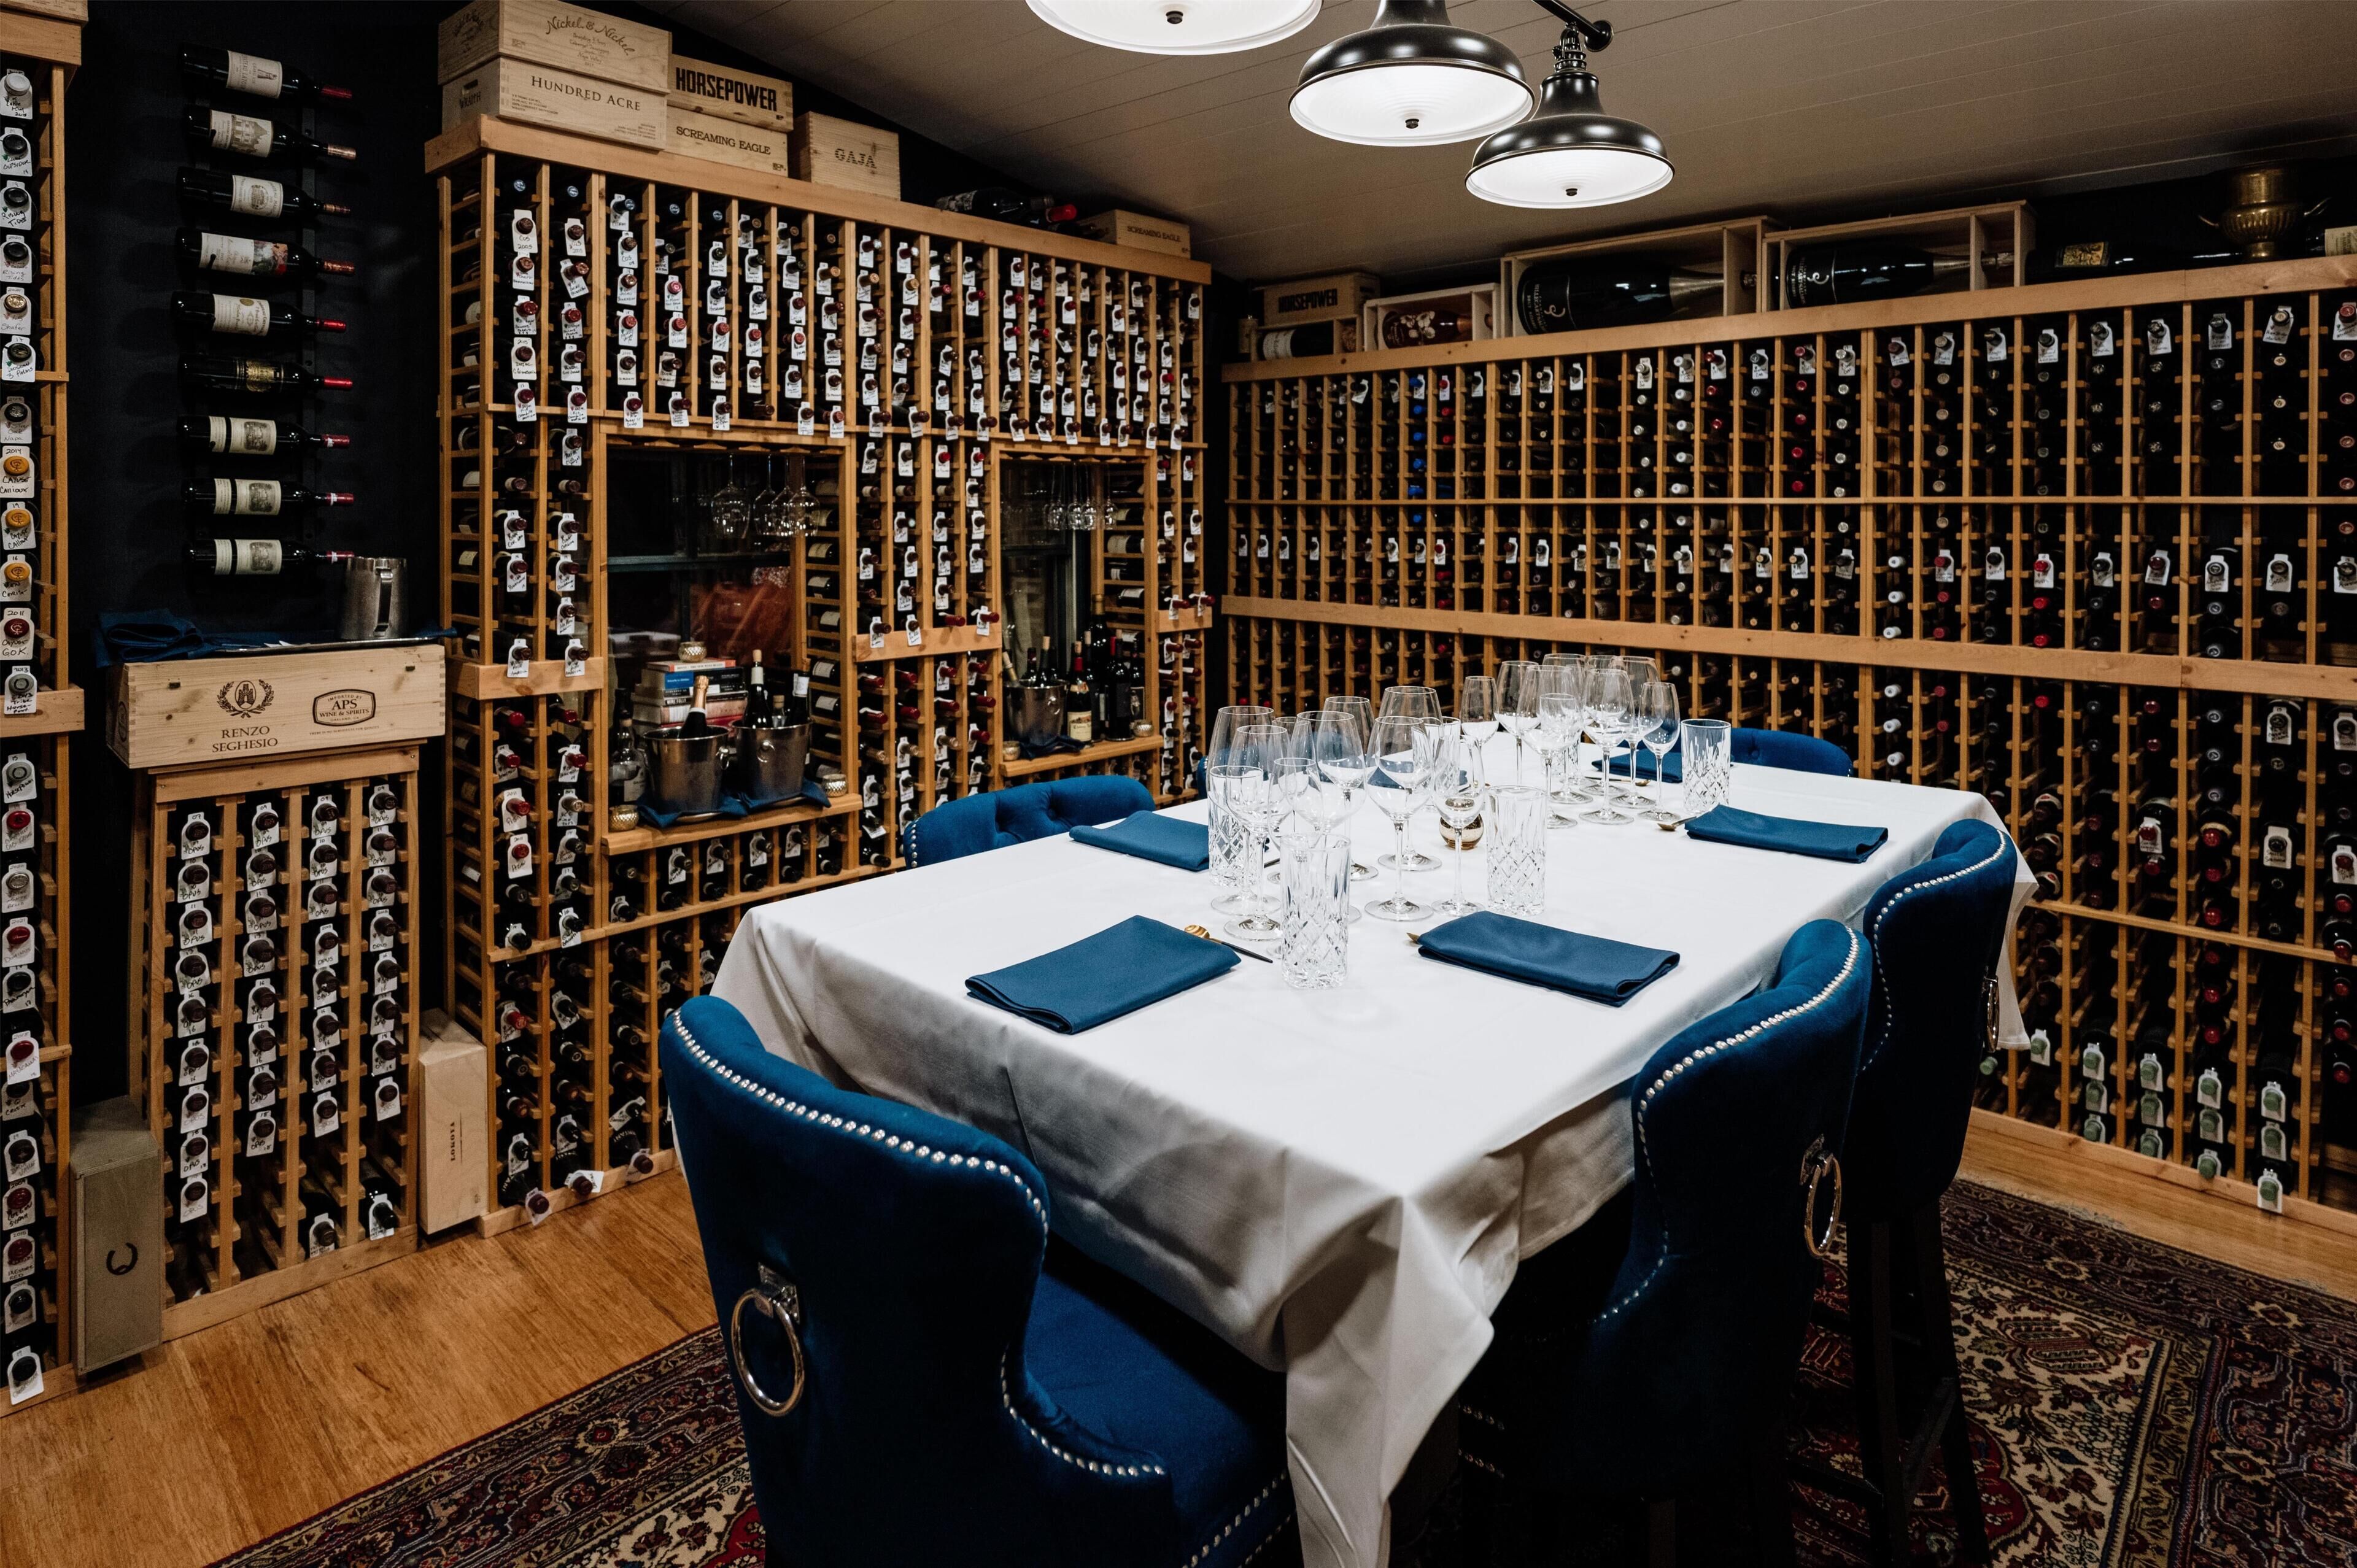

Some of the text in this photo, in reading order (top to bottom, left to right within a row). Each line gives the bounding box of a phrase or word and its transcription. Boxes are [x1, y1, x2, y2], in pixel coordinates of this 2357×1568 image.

[546, 16, 635, 56] Nickel & Nickel
[531, 75, 602, 101] HUNDRED
[606, 95, 641, 111] ACRE
[676, 67, 777, 112] HORSEPOWER
[676, 126, 735, 147] SCREAMING
[739, 141, 771, 155] EAGLE
[835, 149, 877, 169] GAJA
[1279, 288, 1338, 313] HORSEPOWER
[332, 699, 358, 710] APS
[222, 726, 270, 738] RENZO
[212, 738, 278, 752] SEGHESIO
[183, 890, 201, 899] OPUS
[254, 922, 271, 931] OPUS
[184, 935, 204, 945] OPUS
[187, 978, 202, 989] OPUS
[251, 1140, 266, 1150] OPUS
[184, 1159, 200, 1172] OPUS
